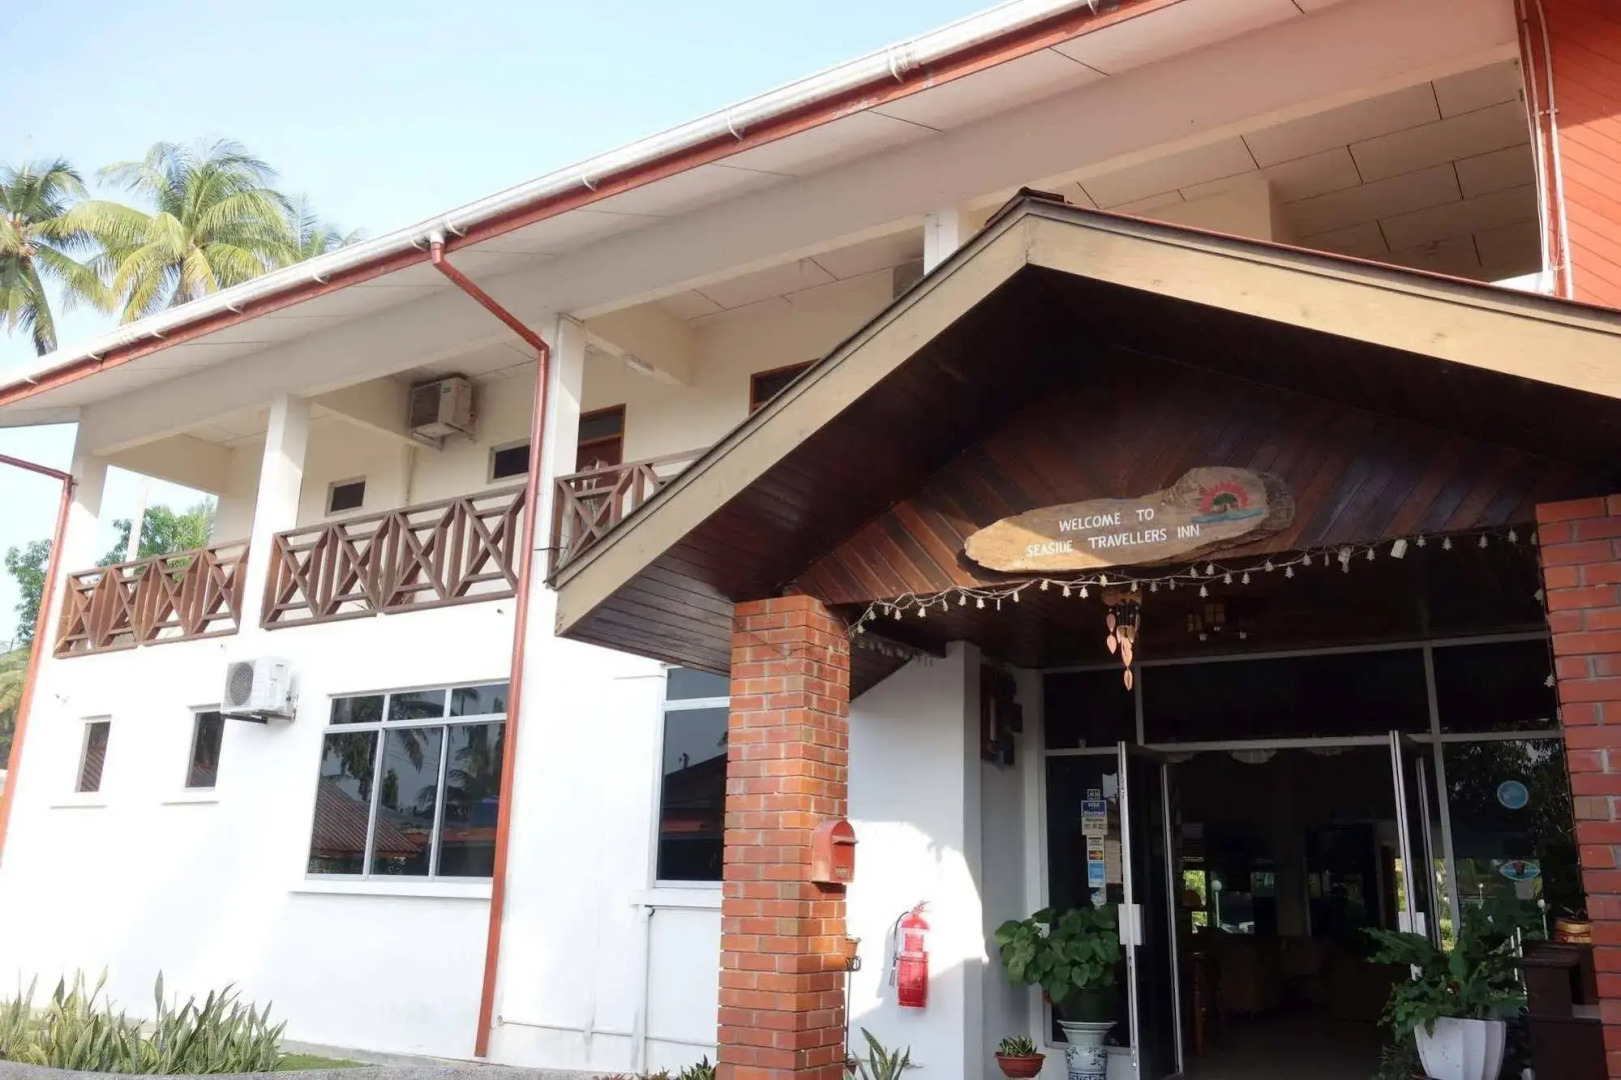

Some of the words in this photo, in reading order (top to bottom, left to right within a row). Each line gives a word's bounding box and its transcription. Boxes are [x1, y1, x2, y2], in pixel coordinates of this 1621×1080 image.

[1058, 512, 1121, 532] WELCOME
[1135, 508, 1154, 522] TO
[1026, 539, 1073, 557] SEASIDE
[1088, 528, 1167, 549] TRAVELLERS
[1177, 524, 1200, 538] INN
